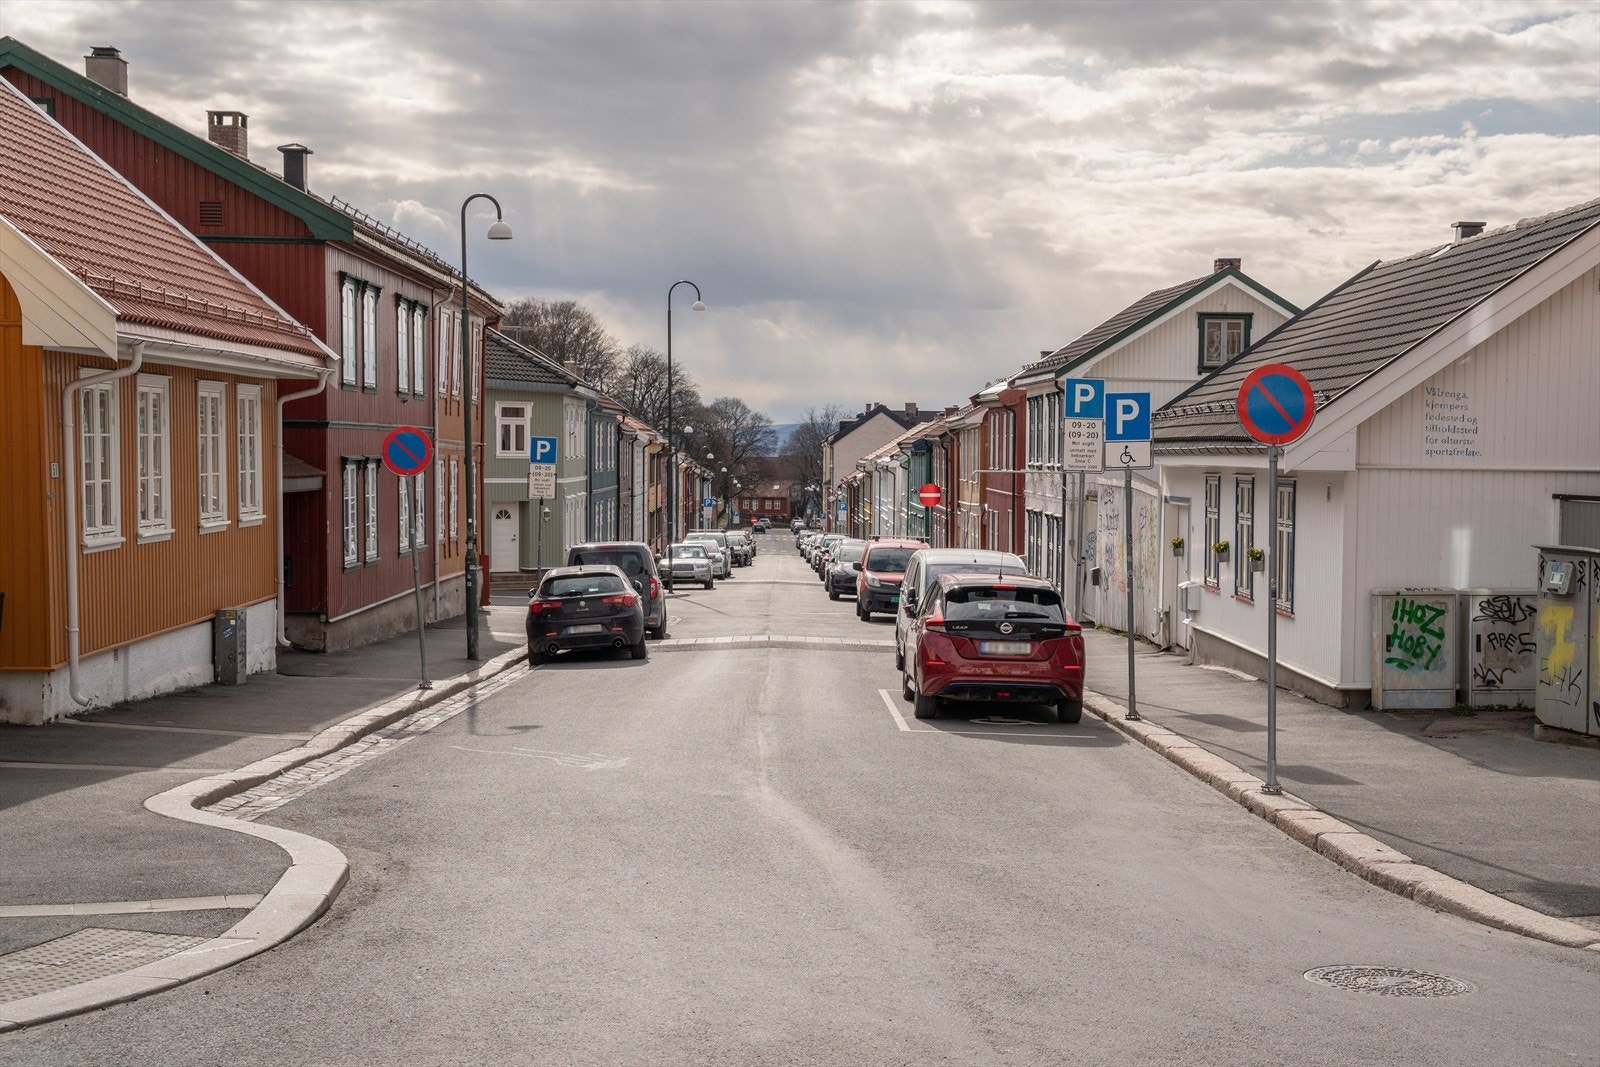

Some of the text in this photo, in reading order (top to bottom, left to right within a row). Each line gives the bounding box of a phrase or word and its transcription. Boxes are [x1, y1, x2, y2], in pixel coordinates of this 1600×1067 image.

[1074, 383, 1095, 413] P
[1425, 400, 1469, 412] kjempers
[1116, 399, 1140, 435] P
[1466, 417, 1478, 425] og
[1425, 424, 1478, 434] tilholdssted
[1425, 435, 1439, 444] for
[536, 440, 551, 460] P
